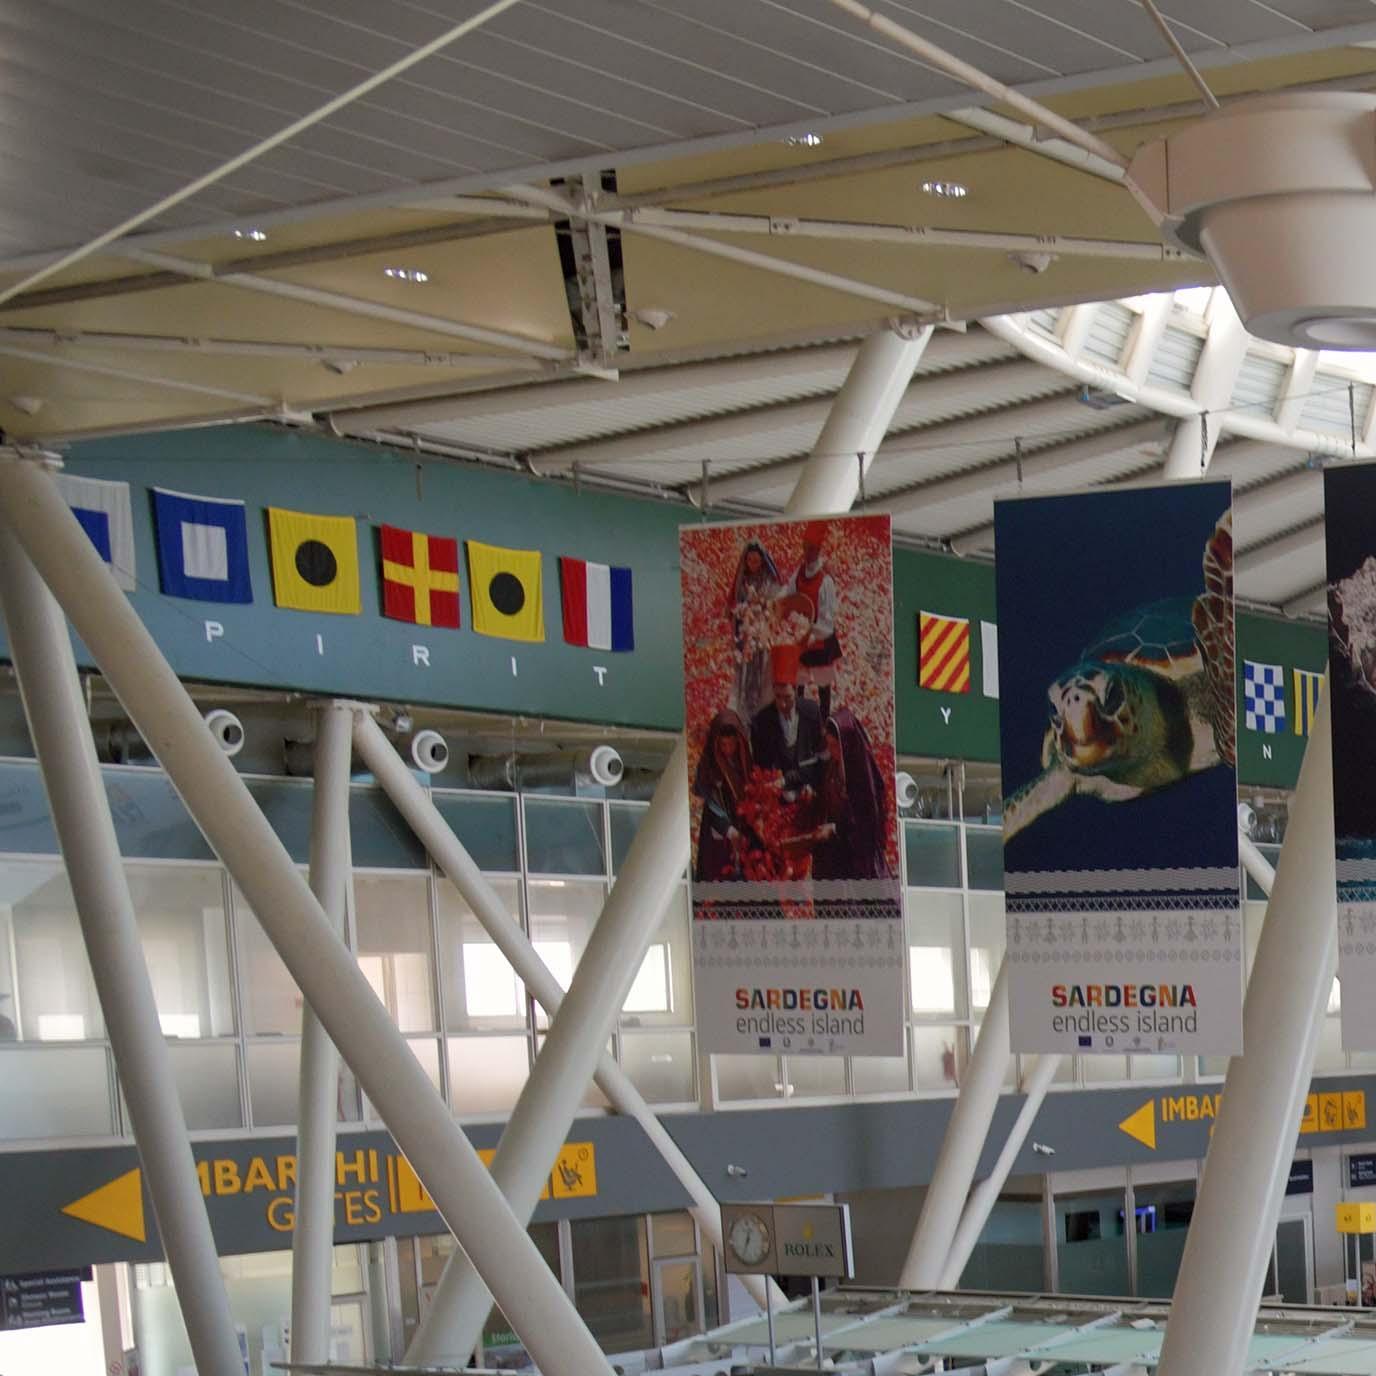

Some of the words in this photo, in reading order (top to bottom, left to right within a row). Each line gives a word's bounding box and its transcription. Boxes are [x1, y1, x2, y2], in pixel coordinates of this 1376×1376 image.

[204, 621, 224, 643] P
[316, 634, 325, 655] I
[412, 645, 430, 667] R
[511, 656, 518, 677] I
[592, 665, 608, 686] T
[940, 706, 952, 725] Y
[1263, 743, 1273, 761] N
[735, 988, 865, 1011] SARDEGNA
[1051, 983, 1197, 1007] SARDEGNA
[736, 1012, 805, 1034] endless
[811, 1012, 865, 1035] island
[1052, 1009, 1130, 1033] endless
[1136, 1009, 1198, 1033] island
[1161, 1093, 1222, 1122] IMBA
[194, 1149, 380, 1197] BARHI
[267, 1190, 382, 1232] GES
[785, 1242, 835, 1258] ROLEX
